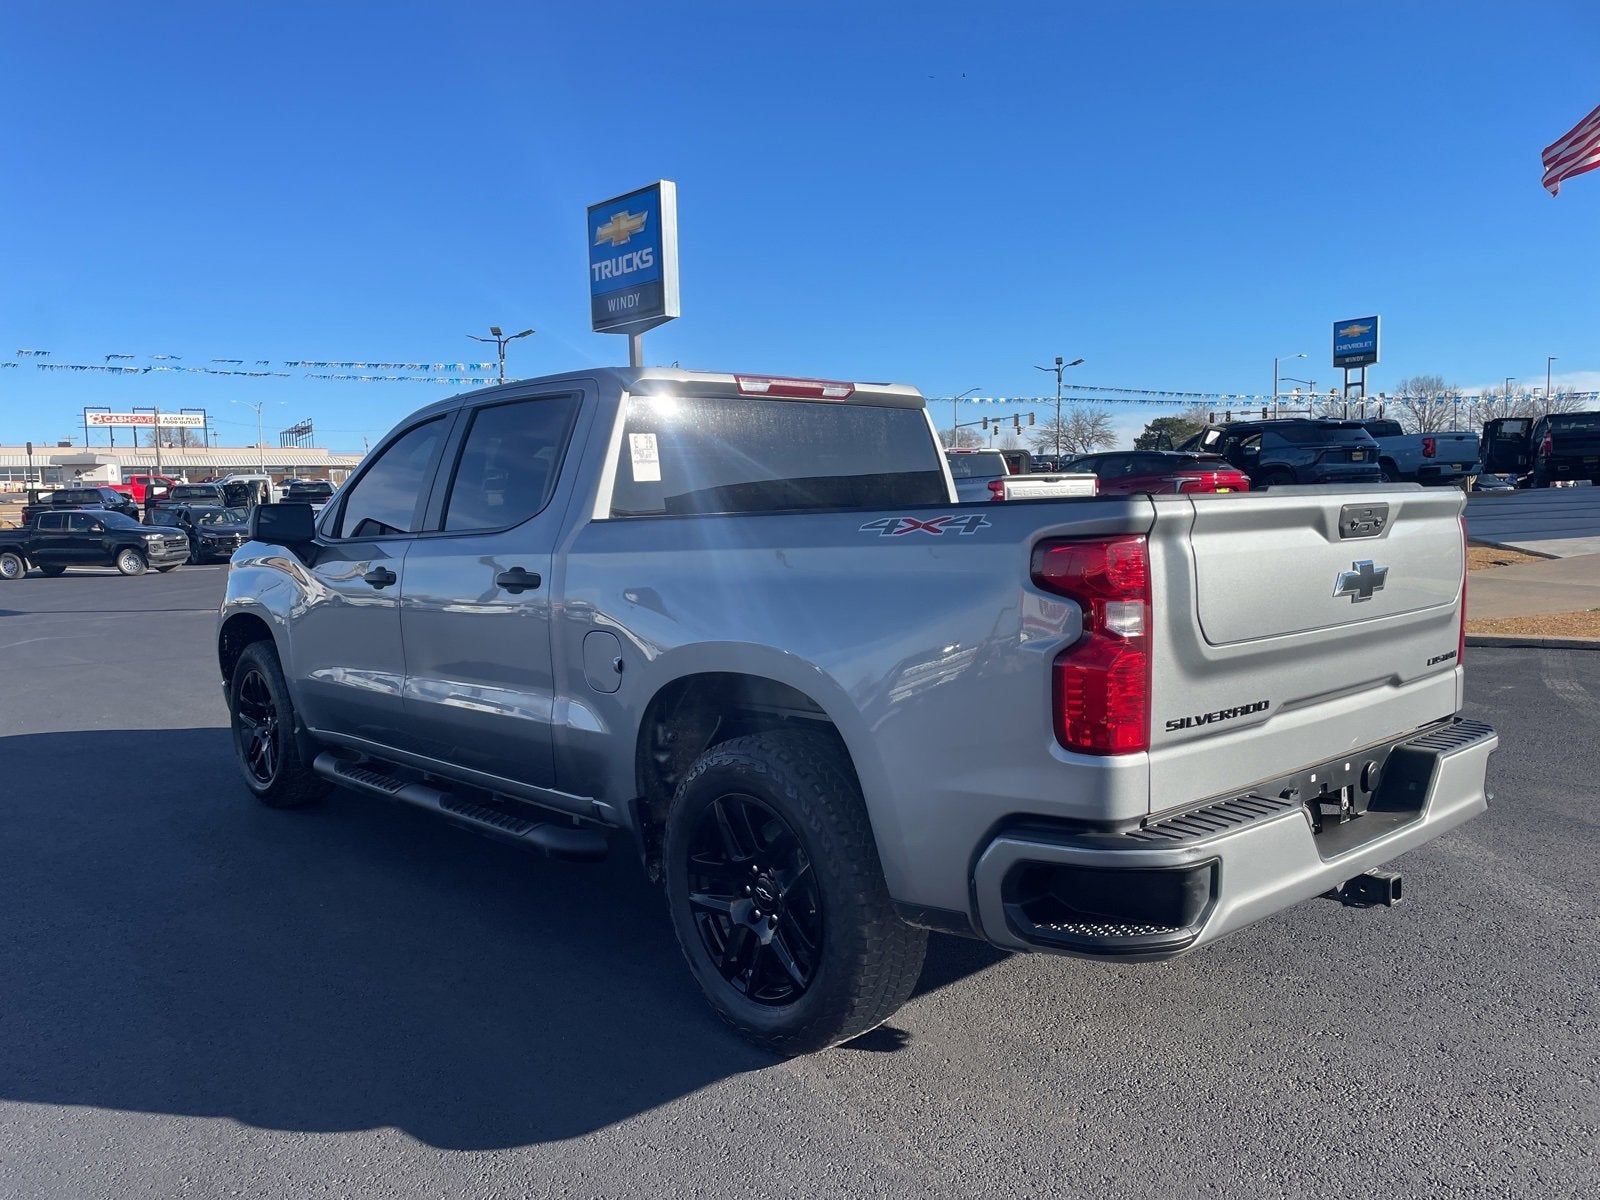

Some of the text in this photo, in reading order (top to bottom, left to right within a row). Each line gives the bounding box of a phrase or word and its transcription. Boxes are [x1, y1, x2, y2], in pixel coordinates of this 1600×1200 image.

[591, 248, 654, 282] TRUCKS
[607, 293, 640, 312] WINDY
[1336, 341, 1372, 350] CHEVROLET
[1165, 700, 1270, 732] SILVERADO
